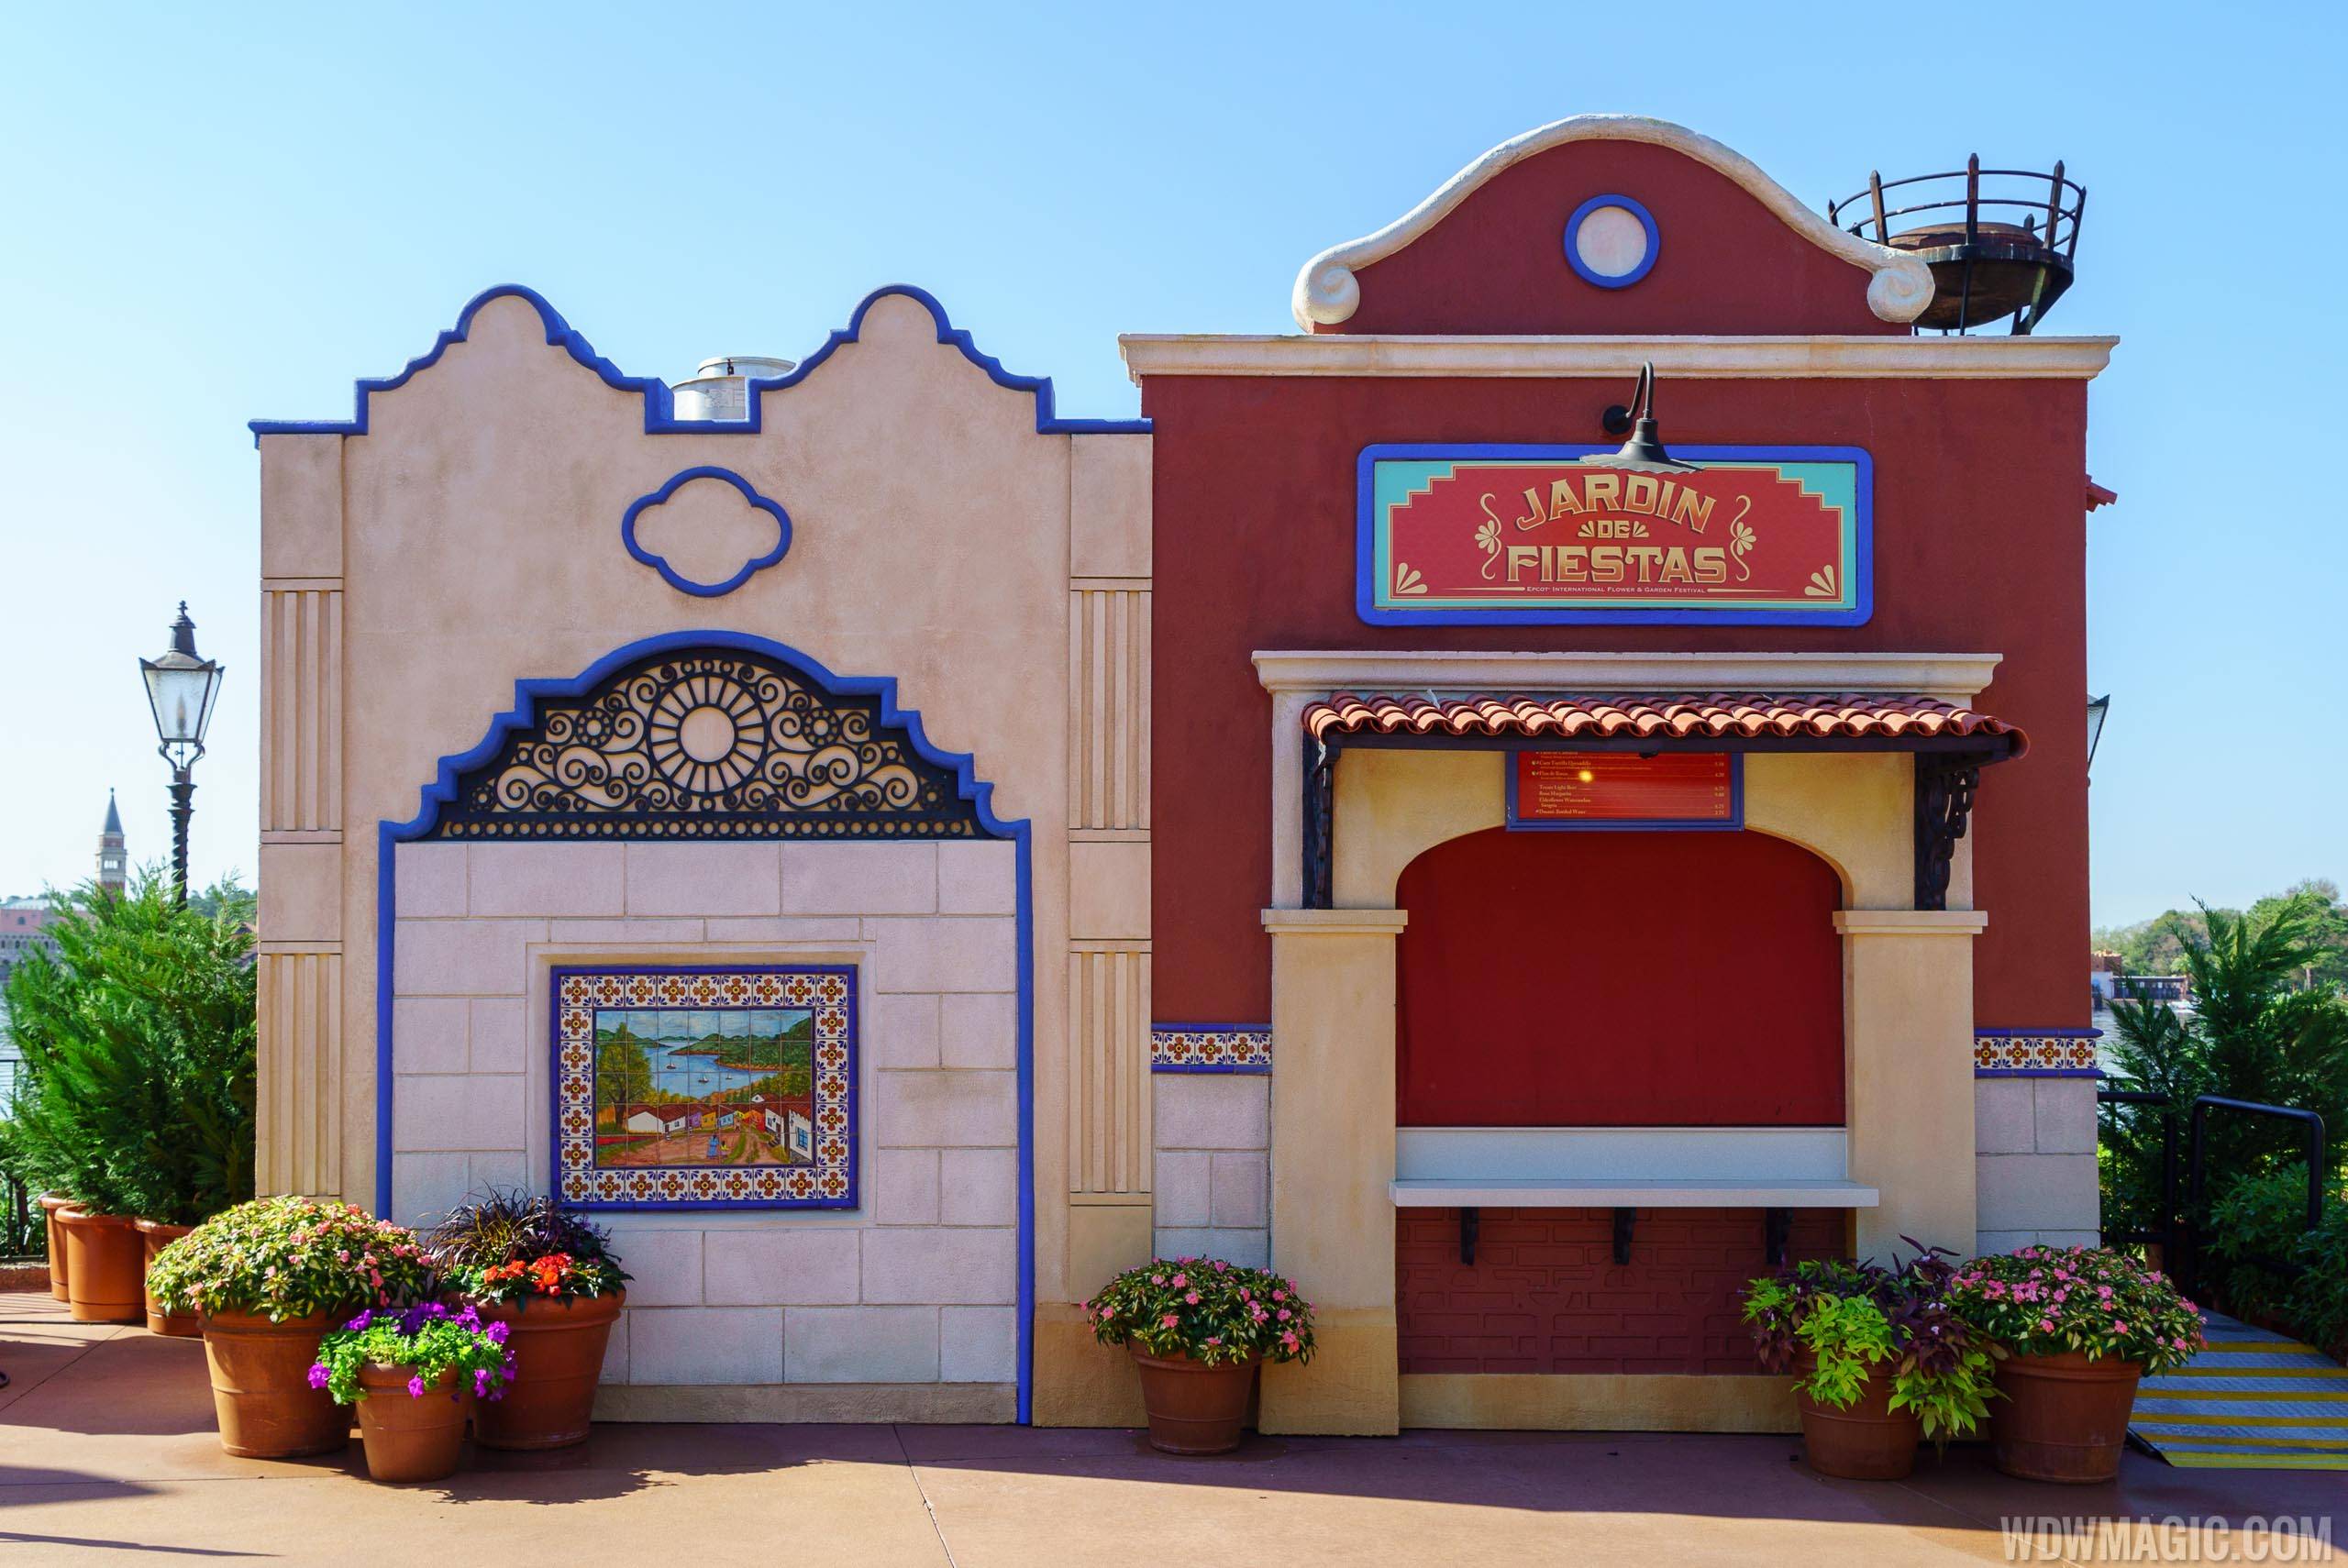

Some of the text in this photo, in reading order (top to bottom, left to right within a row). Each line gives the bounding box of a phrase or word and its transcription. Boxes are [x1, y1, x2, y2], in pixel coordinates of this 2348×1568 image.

[1516, 474, 1716, 533] JARDIN
[1597, 520, 1631, 539] DE
[1506, 546, 1726, 582] FIESTAS
